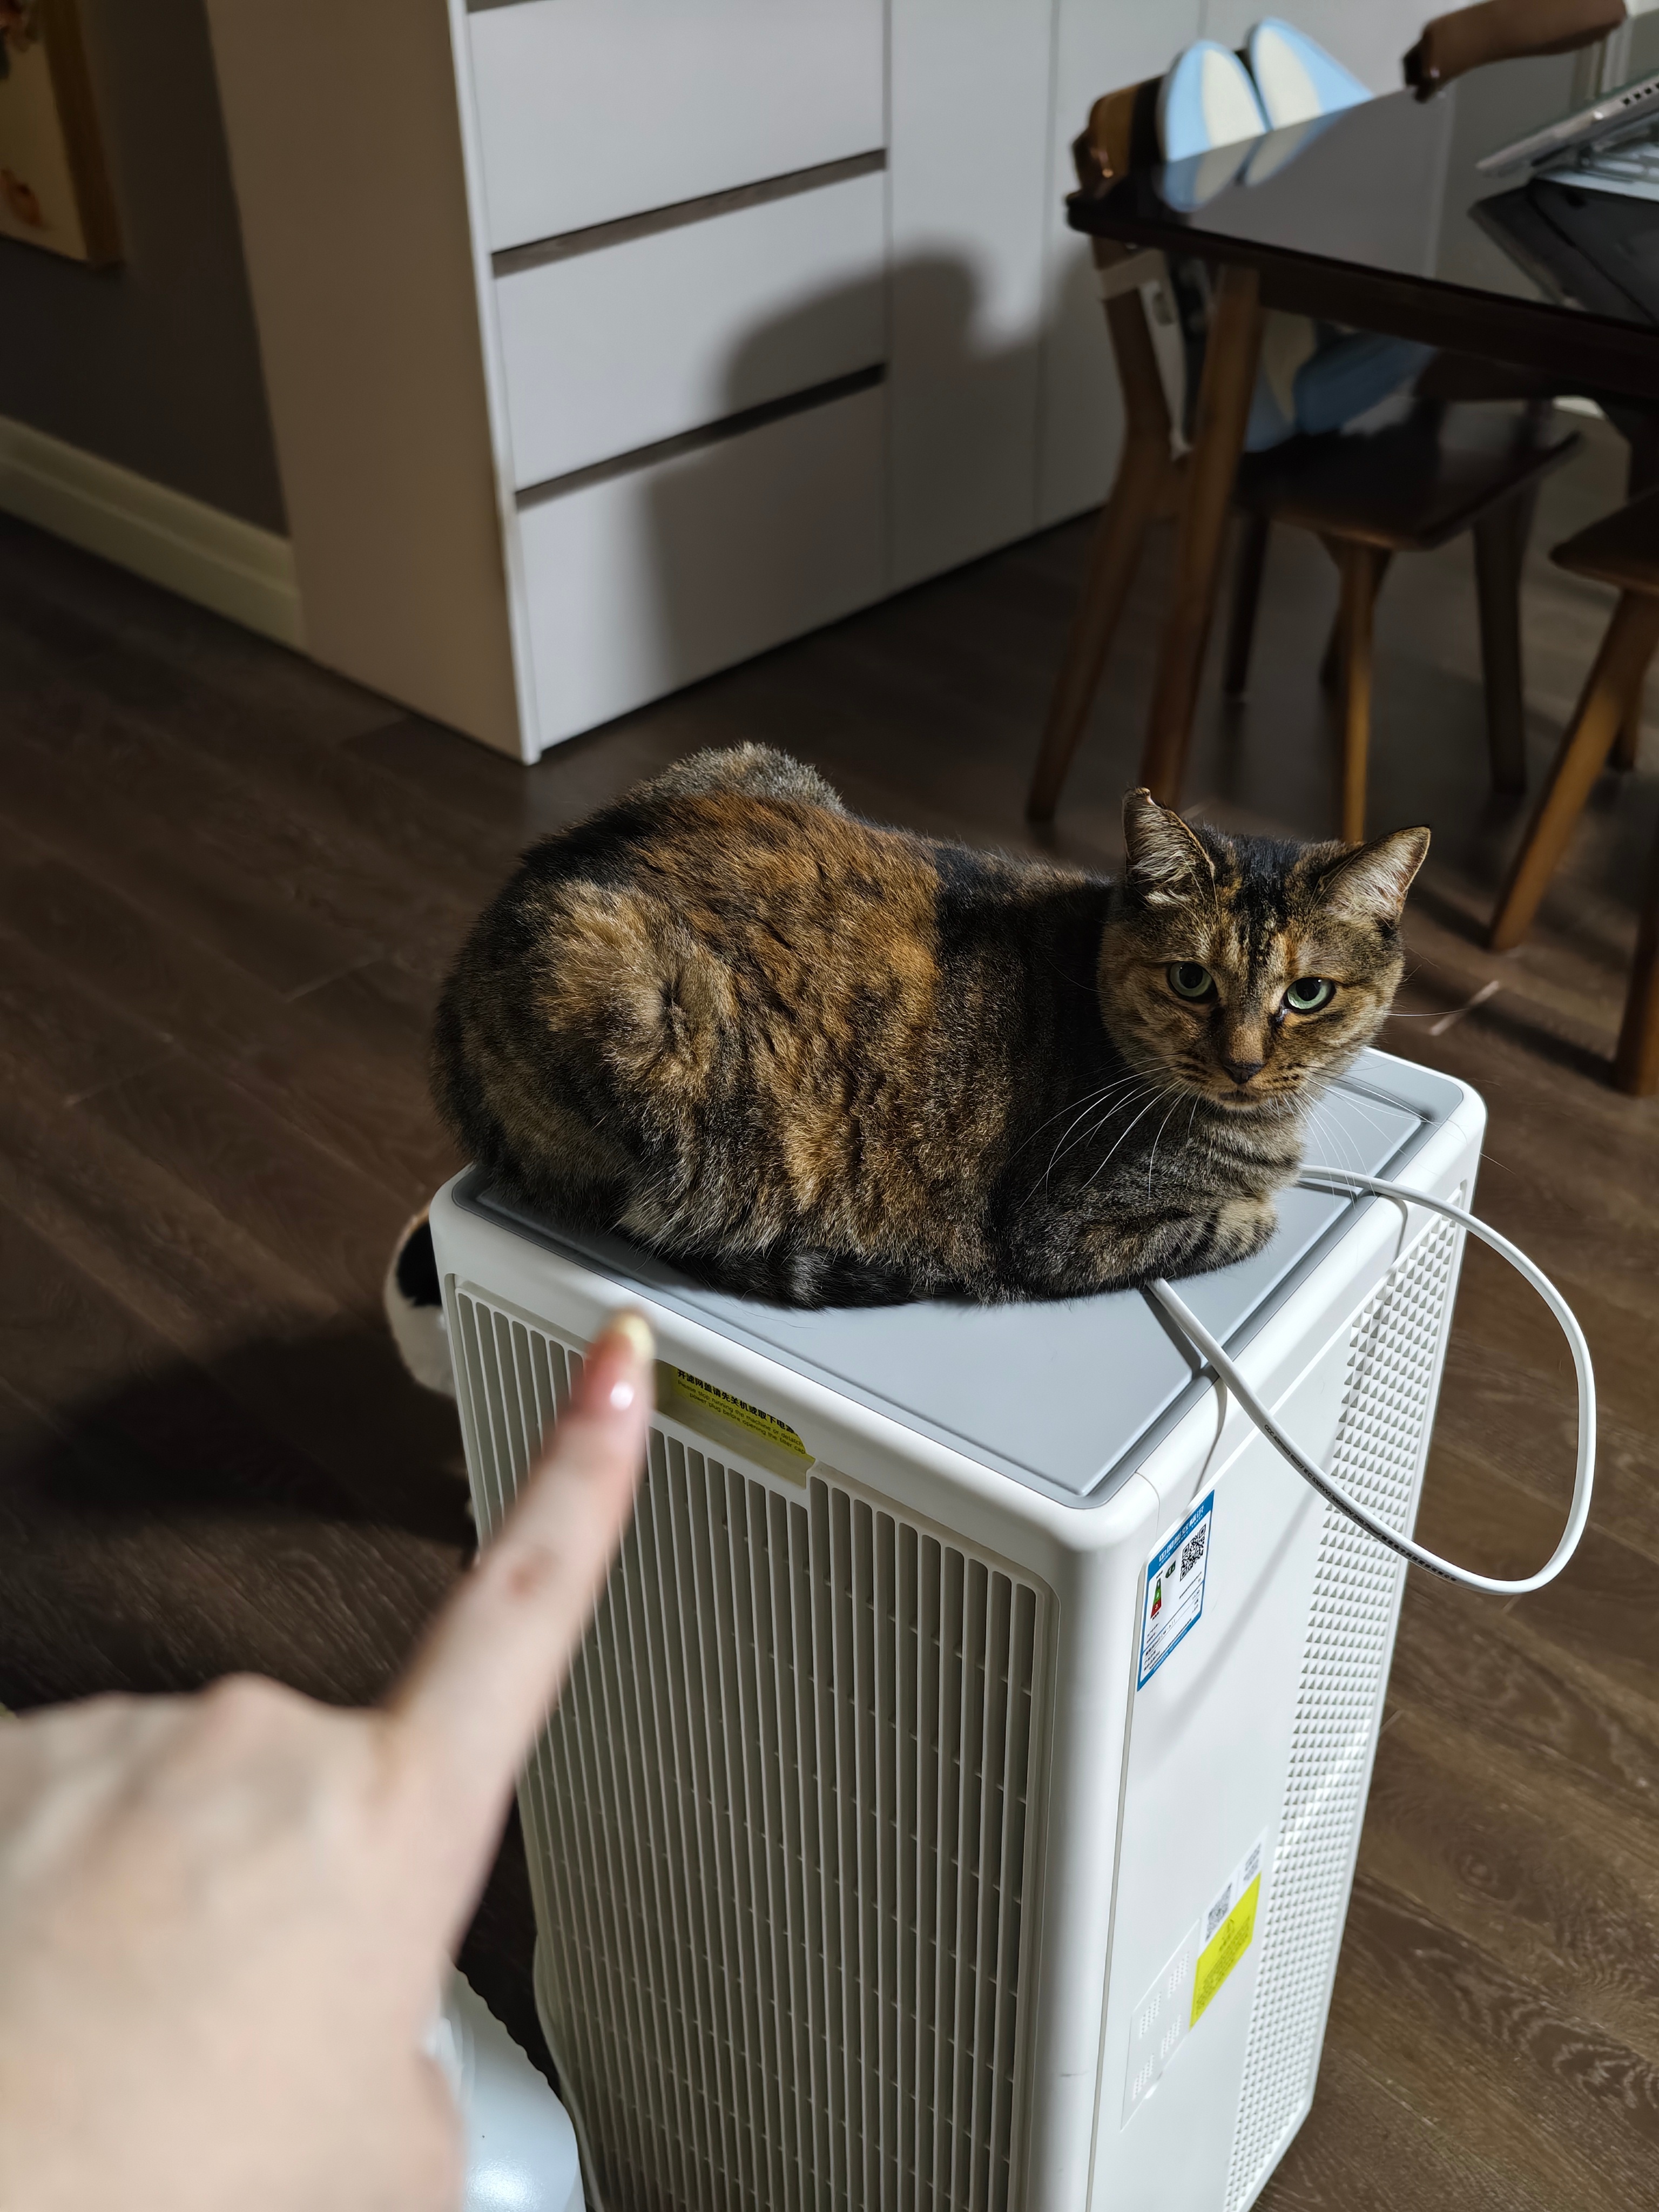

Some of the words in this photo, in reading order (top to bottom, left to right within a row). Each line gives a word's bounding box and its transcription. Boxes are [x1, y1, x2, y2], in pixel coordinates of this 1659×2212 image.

[690, 1393, 706, 1404] power
[709, 1403, 721, 1413] plug
[723, 1410, 740, 1422] before
[743, 1419, 766, 1435] opening
[768, 1432, 777, 1441] the
[794, 1446, 806, 1454] cap
[698, 1391, 710, 1400] stop
[712, 1398, 733, 1413] running
[746, 1415, 771, 1431] machine
